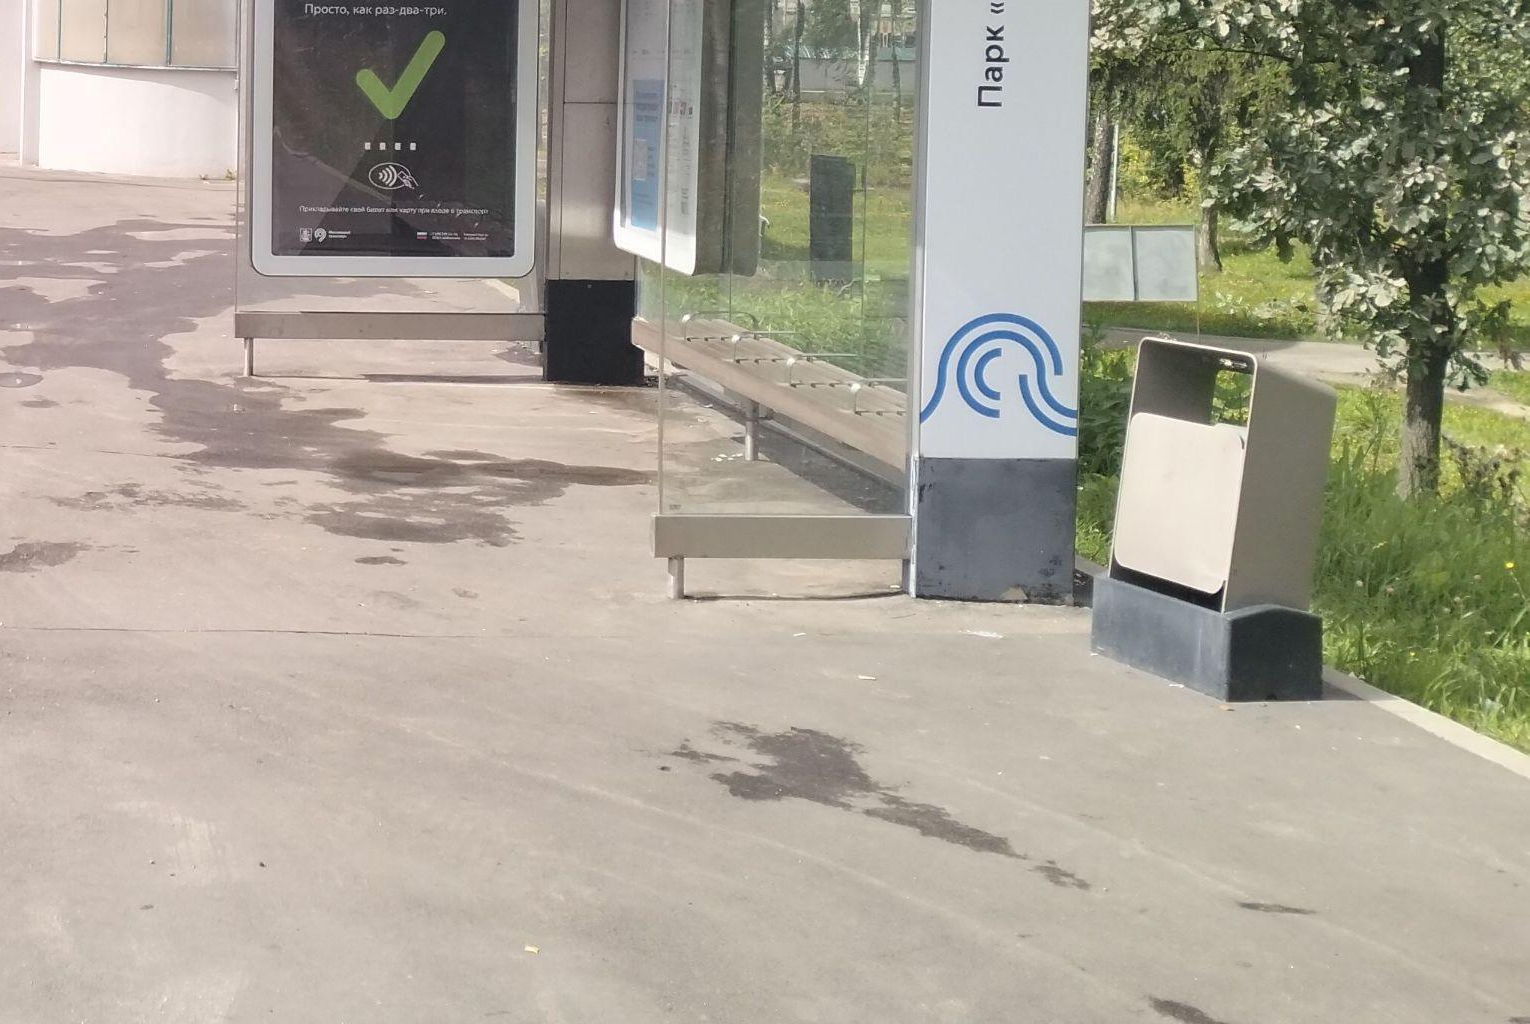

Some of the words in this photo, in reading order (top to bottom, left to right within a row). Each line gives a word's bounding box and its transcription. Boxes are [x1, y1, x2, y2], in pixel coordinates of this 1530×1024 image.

[304, 3, 350, 15] Просто,
[353, 5, 372, 15] как
[977, 25, 1010, 108] Парк
